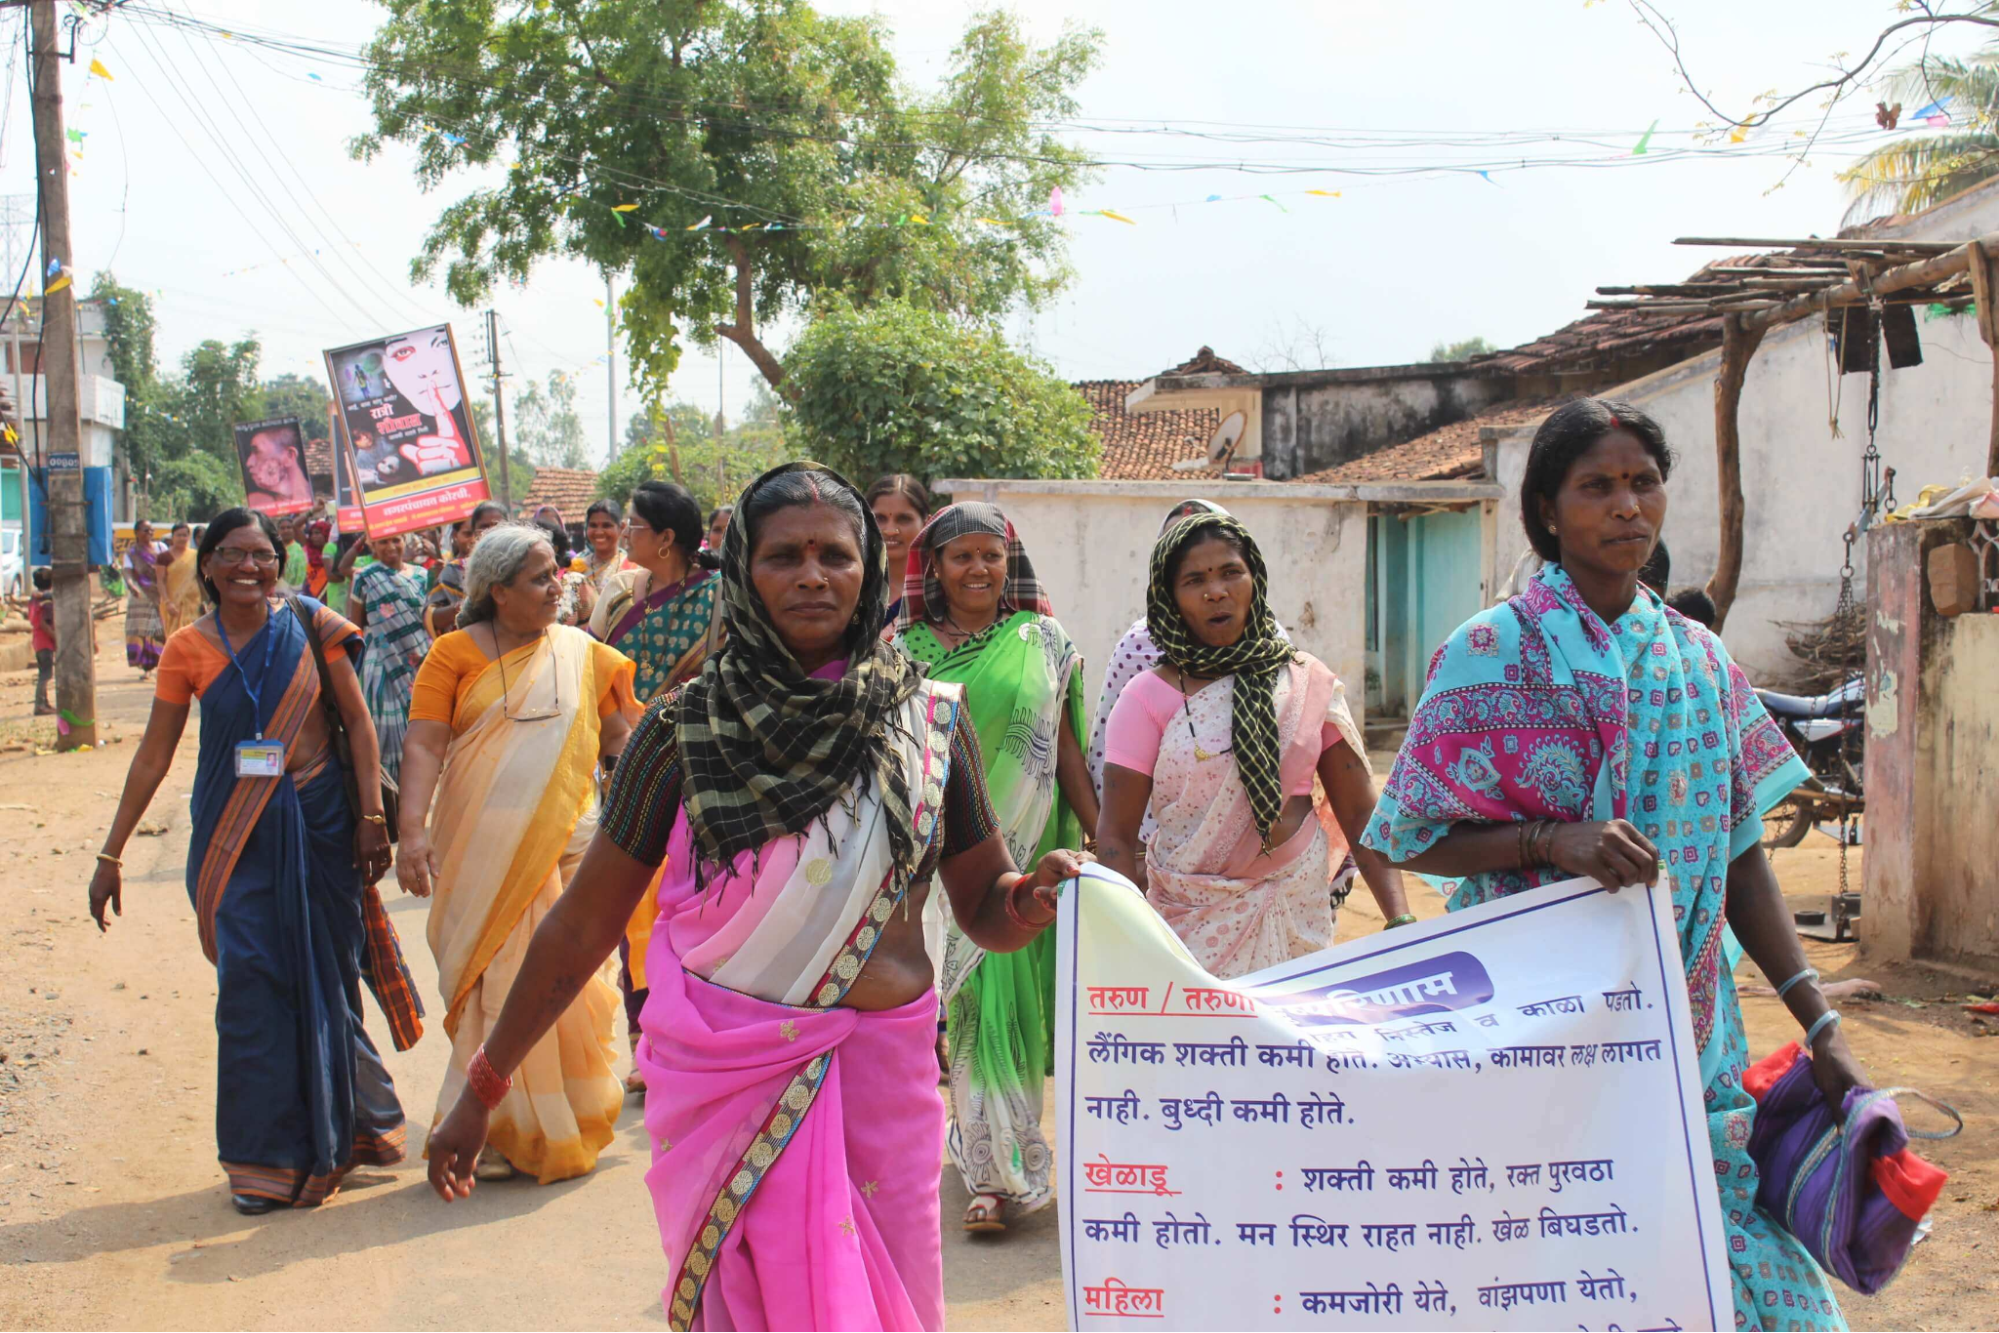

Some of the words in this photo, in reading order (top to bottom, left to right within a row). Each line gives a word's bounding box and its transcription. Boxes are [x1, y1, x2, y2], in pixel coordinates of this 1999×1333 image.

[1086, 986, 1149, 1010] तरुण
[1517, 995, 1585, 1017] काळा
[1602, 980, 1654, 1013] पडतो.
[1086, 1031, 1166, 1064] लैंगिक
[1172, 1035, 1249, 1068] शक्ती
[1255, 1039, 1315, 1069] कमी
[1489, 1045, 1567, 1068] कामावर
[1570, 1043, 1599, 1067] लक्ष
[1600, 1039, 1662, 1064] लागत
[1084, 1089, 1150, 1126] नाही.
[1229, 1092, 1291, 1124] कमी
[1296, 1091, 1355, 1130] होते.
[1083, 1153, 1174, 1197] खेळाडू
[1300, 1159, 1375, 1193] शक्ती
[1386, 1159, 1438, 1191] कमी
[1448, 1157, 1496, 1195] होते,
[1505, 1163, 1542, 1188] रक्त
[1548, 1158, 1614, 1194] पुरवठा
[1082, 1211, 1141, 1243] कमी
[1151, 1211, 1221, 1250] होतो.
[1235, 1223, 1278, 1247] मन
[1288, 1213, 1350, 1248] स्थिर
[1360, 1224, 1417, 1252] राहत
[1425, 1213, 1483, 1250] नाही.
[1491, 1210, 1531, 1243] खेळ
[1537, 1202, 1639, 1239] बिघडतो.
[1082, 1276, 1165, 1315] महिला
[1299, 1281, 1403, 1315] कमजोरी
[1412, 1280, 1457, 1317] येते,
[1477, 1276, 1567, 1312] वांझपणा
[1576, 1268, 1637, 1304] येतो,
